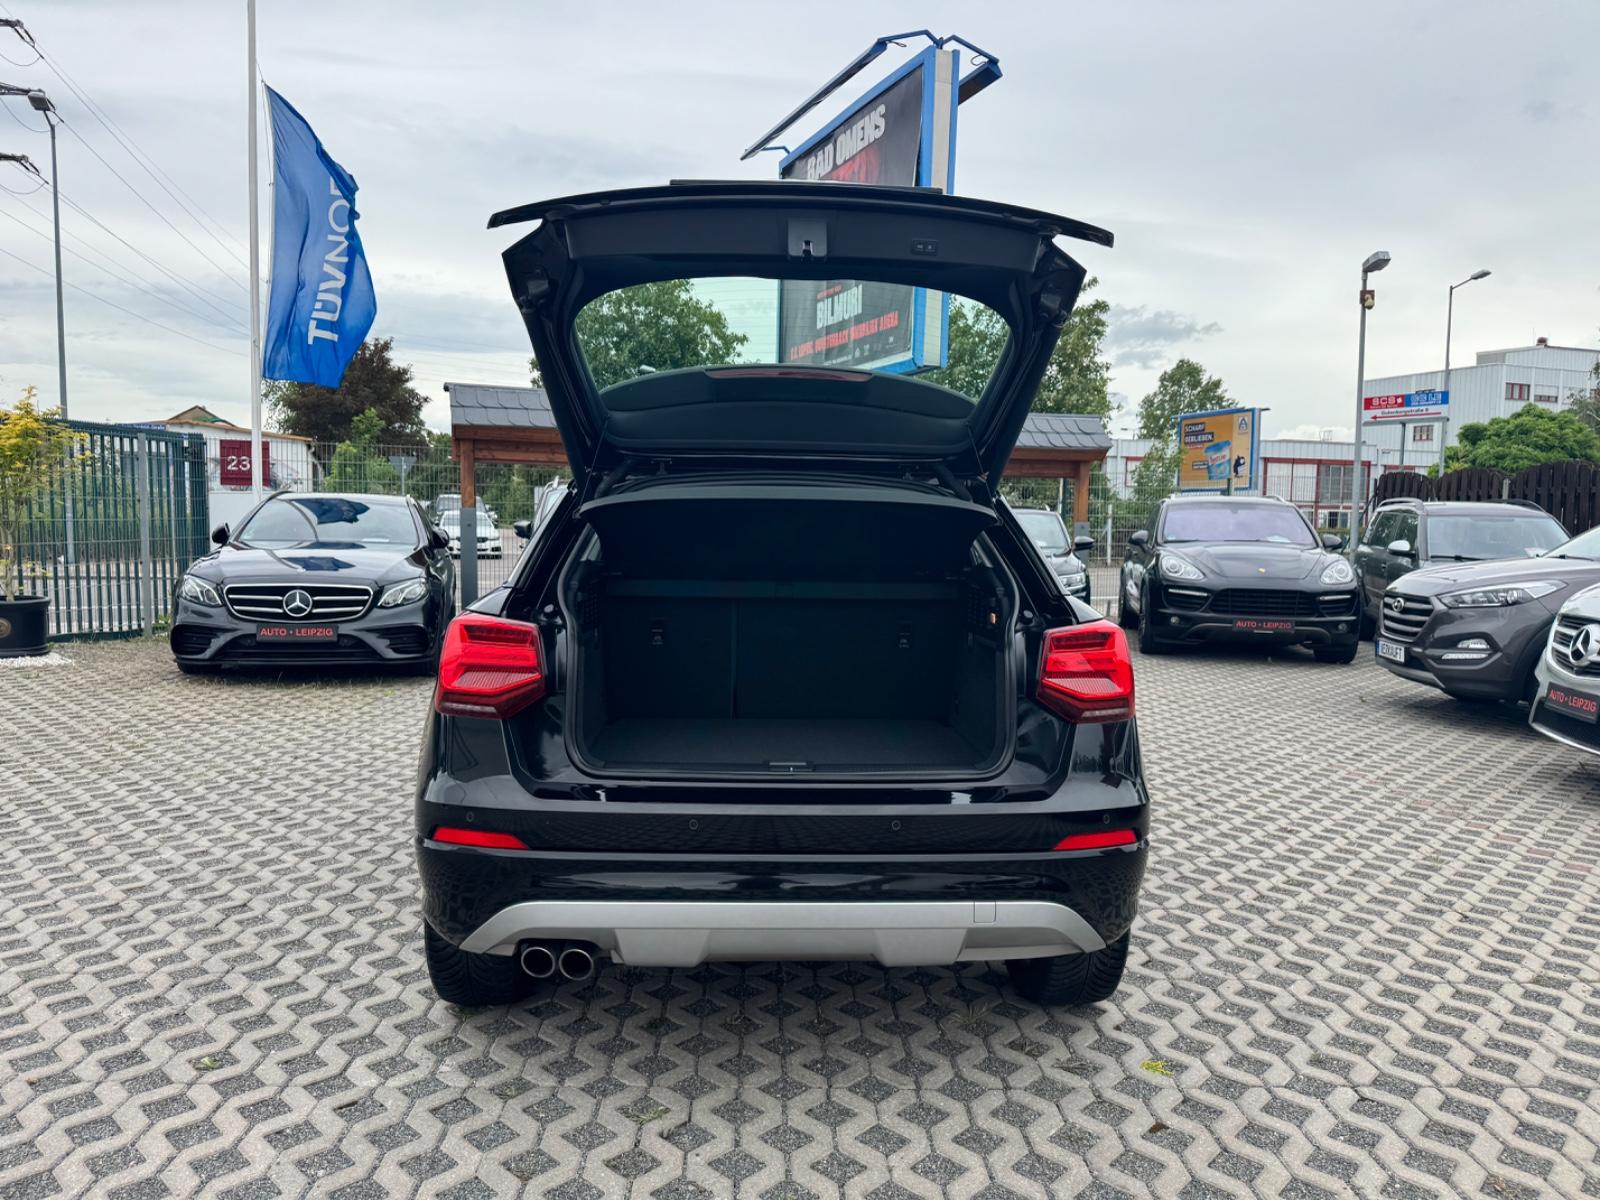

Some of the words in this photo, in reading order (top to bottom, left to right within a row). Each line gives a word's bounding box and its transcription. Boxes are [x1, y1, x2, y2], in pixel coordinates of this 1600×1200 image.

[807, 143, 835, 180] BAD
[835, 104, 886, 166] OMENS
[816, 284, 863, 330] BILMURI
[1372, 396, 1396, 406] SCS
[227, 455, 251, 472] 23
[260, 627, 287, 637] AUTO
[295, 627, 334, 637] LEIPZIG
[1236, 620, 1257, 628] AUTO
[1263, 621, 1292, 629] LEIPZIG
[1549, 688, 1565, 703] AUTO
[1568, 695, 1598, 713] LEIPZIG
